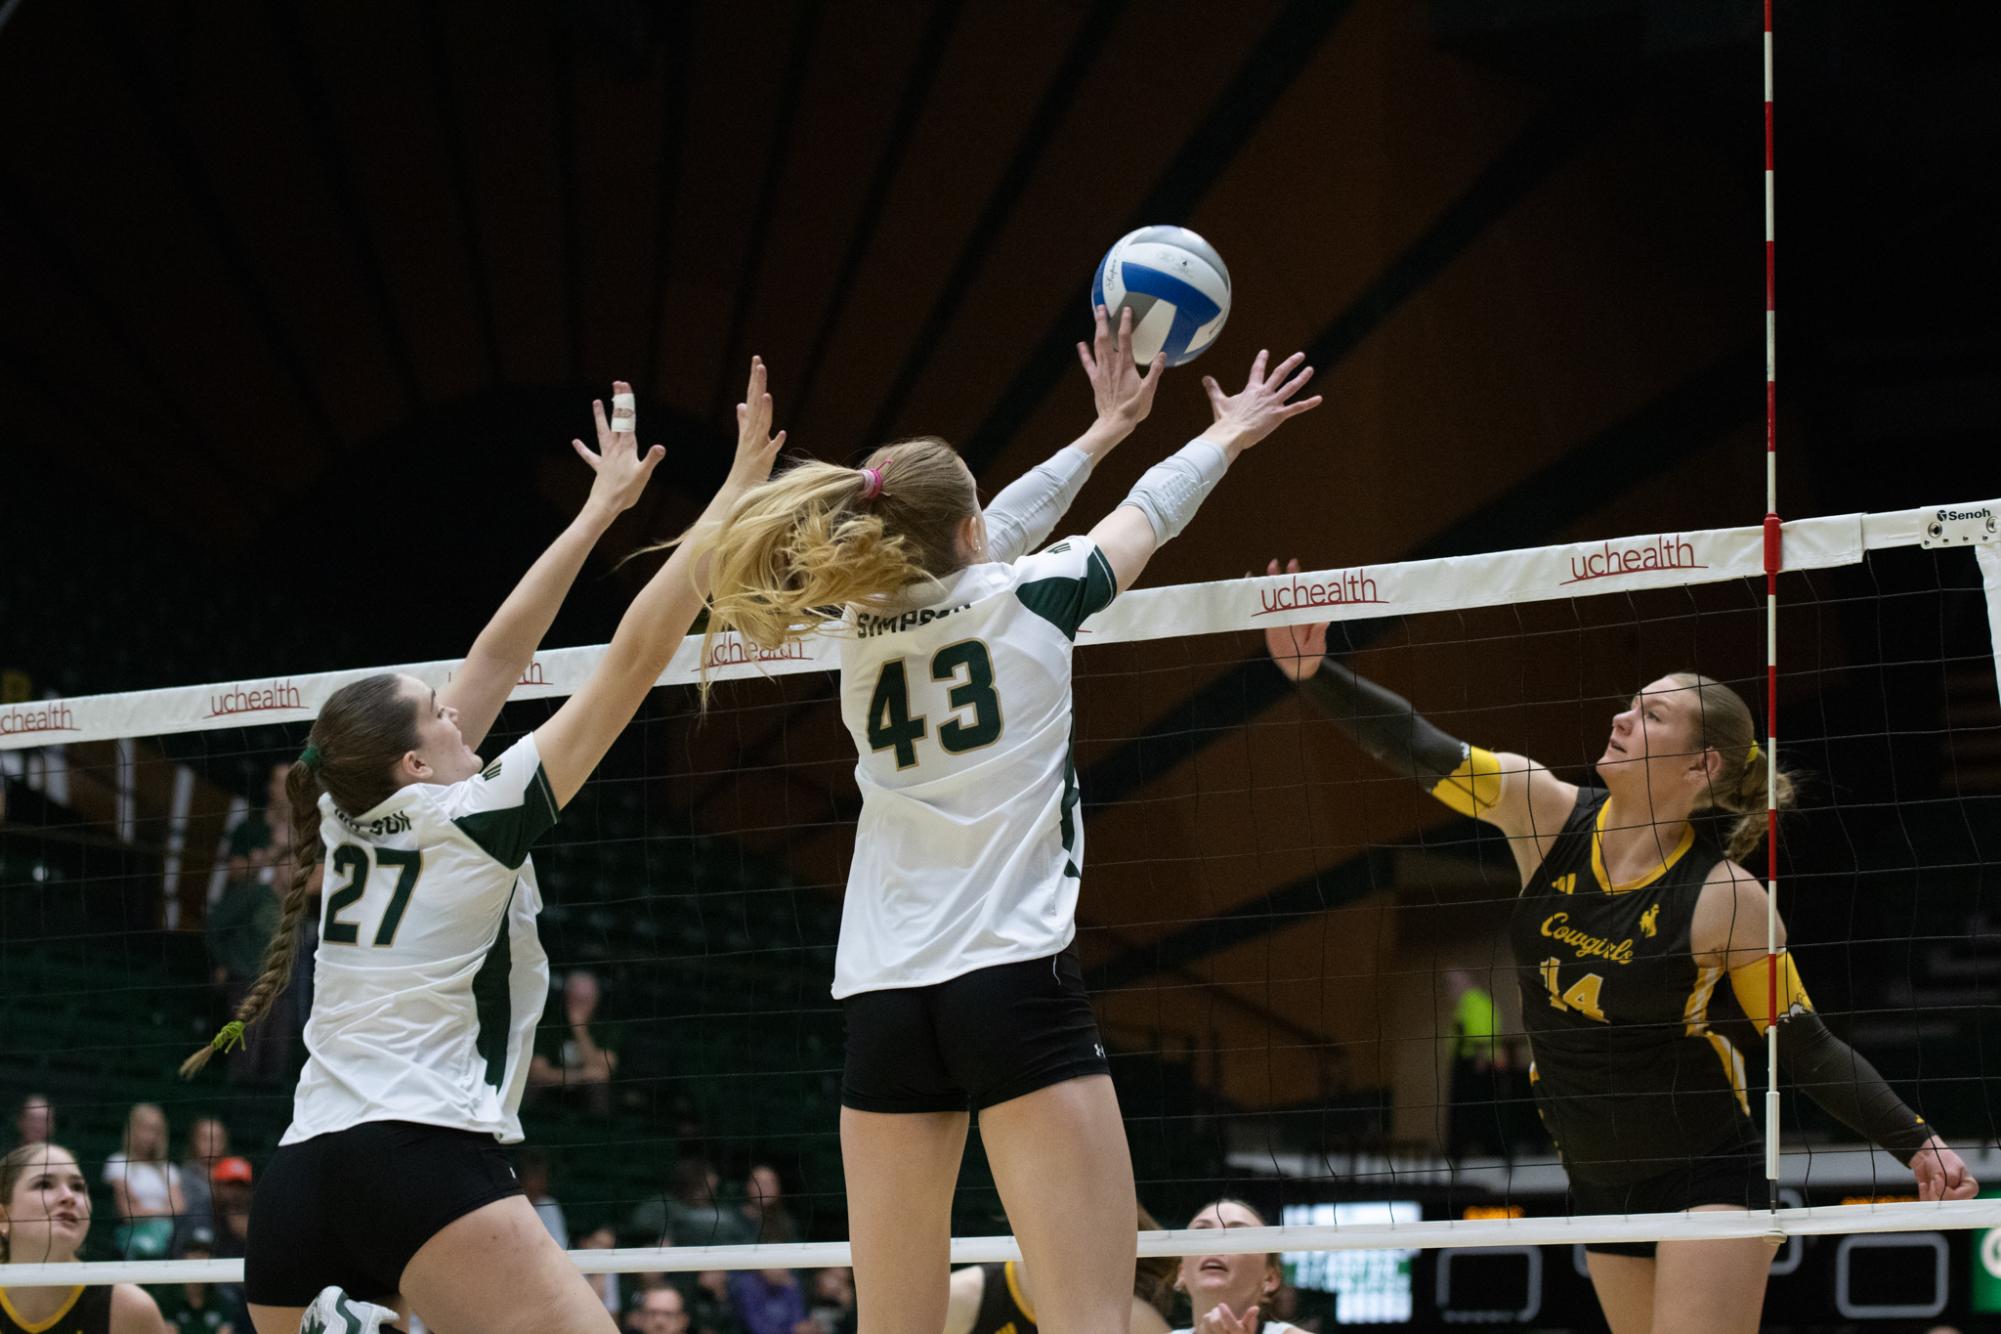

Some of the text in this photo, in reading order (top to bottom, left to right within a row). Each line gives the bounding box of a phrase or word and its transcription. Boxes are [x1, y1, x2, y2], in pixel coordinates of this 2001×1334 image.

[1948, 508, 1991, 521] Senoh
[1571, 534, 1695, 580] uchealth
[1261, 568, 1377, 612] uchealth
[0, 702, 73, 734] chealth
[211, 679, 301, 716] uchealth
[866, 637, 1004, 771] 43
[323, 842, 424, 947] 27
[1541, 912, 1633, 965] Cowgirls
[1540, 957, 1611, 1024] 14
